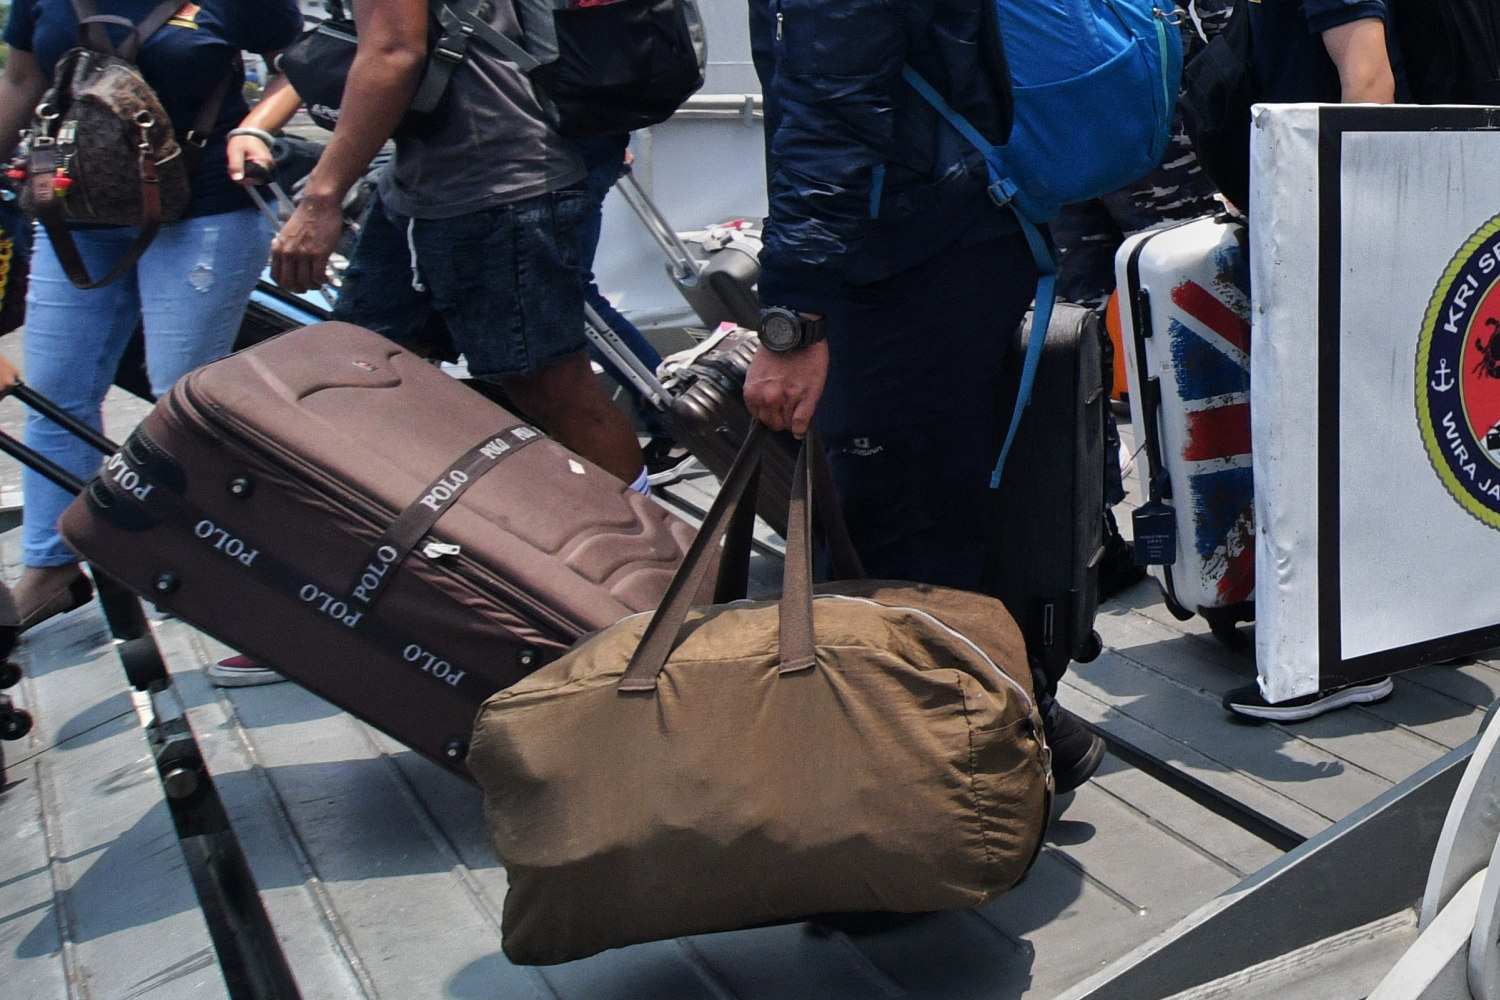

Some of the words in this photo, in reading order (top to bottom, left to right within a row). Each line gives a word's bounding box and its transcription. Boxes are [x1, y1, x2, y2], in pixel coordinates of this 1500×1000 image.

[1443, 274, 1479, 334] KRI
[1441, 411, 1477, 481] WIRA
[107, 452, 154, 501] POLO
[194, 520, 260, 567] POLO
[299, 584, 365, 629] POLO
[402, 644, 467, 688] POLO
[354, 545, 398, 603] POLO
[420, 469, 469, 512] POLO
[479, 438, 511, 460] POLO
